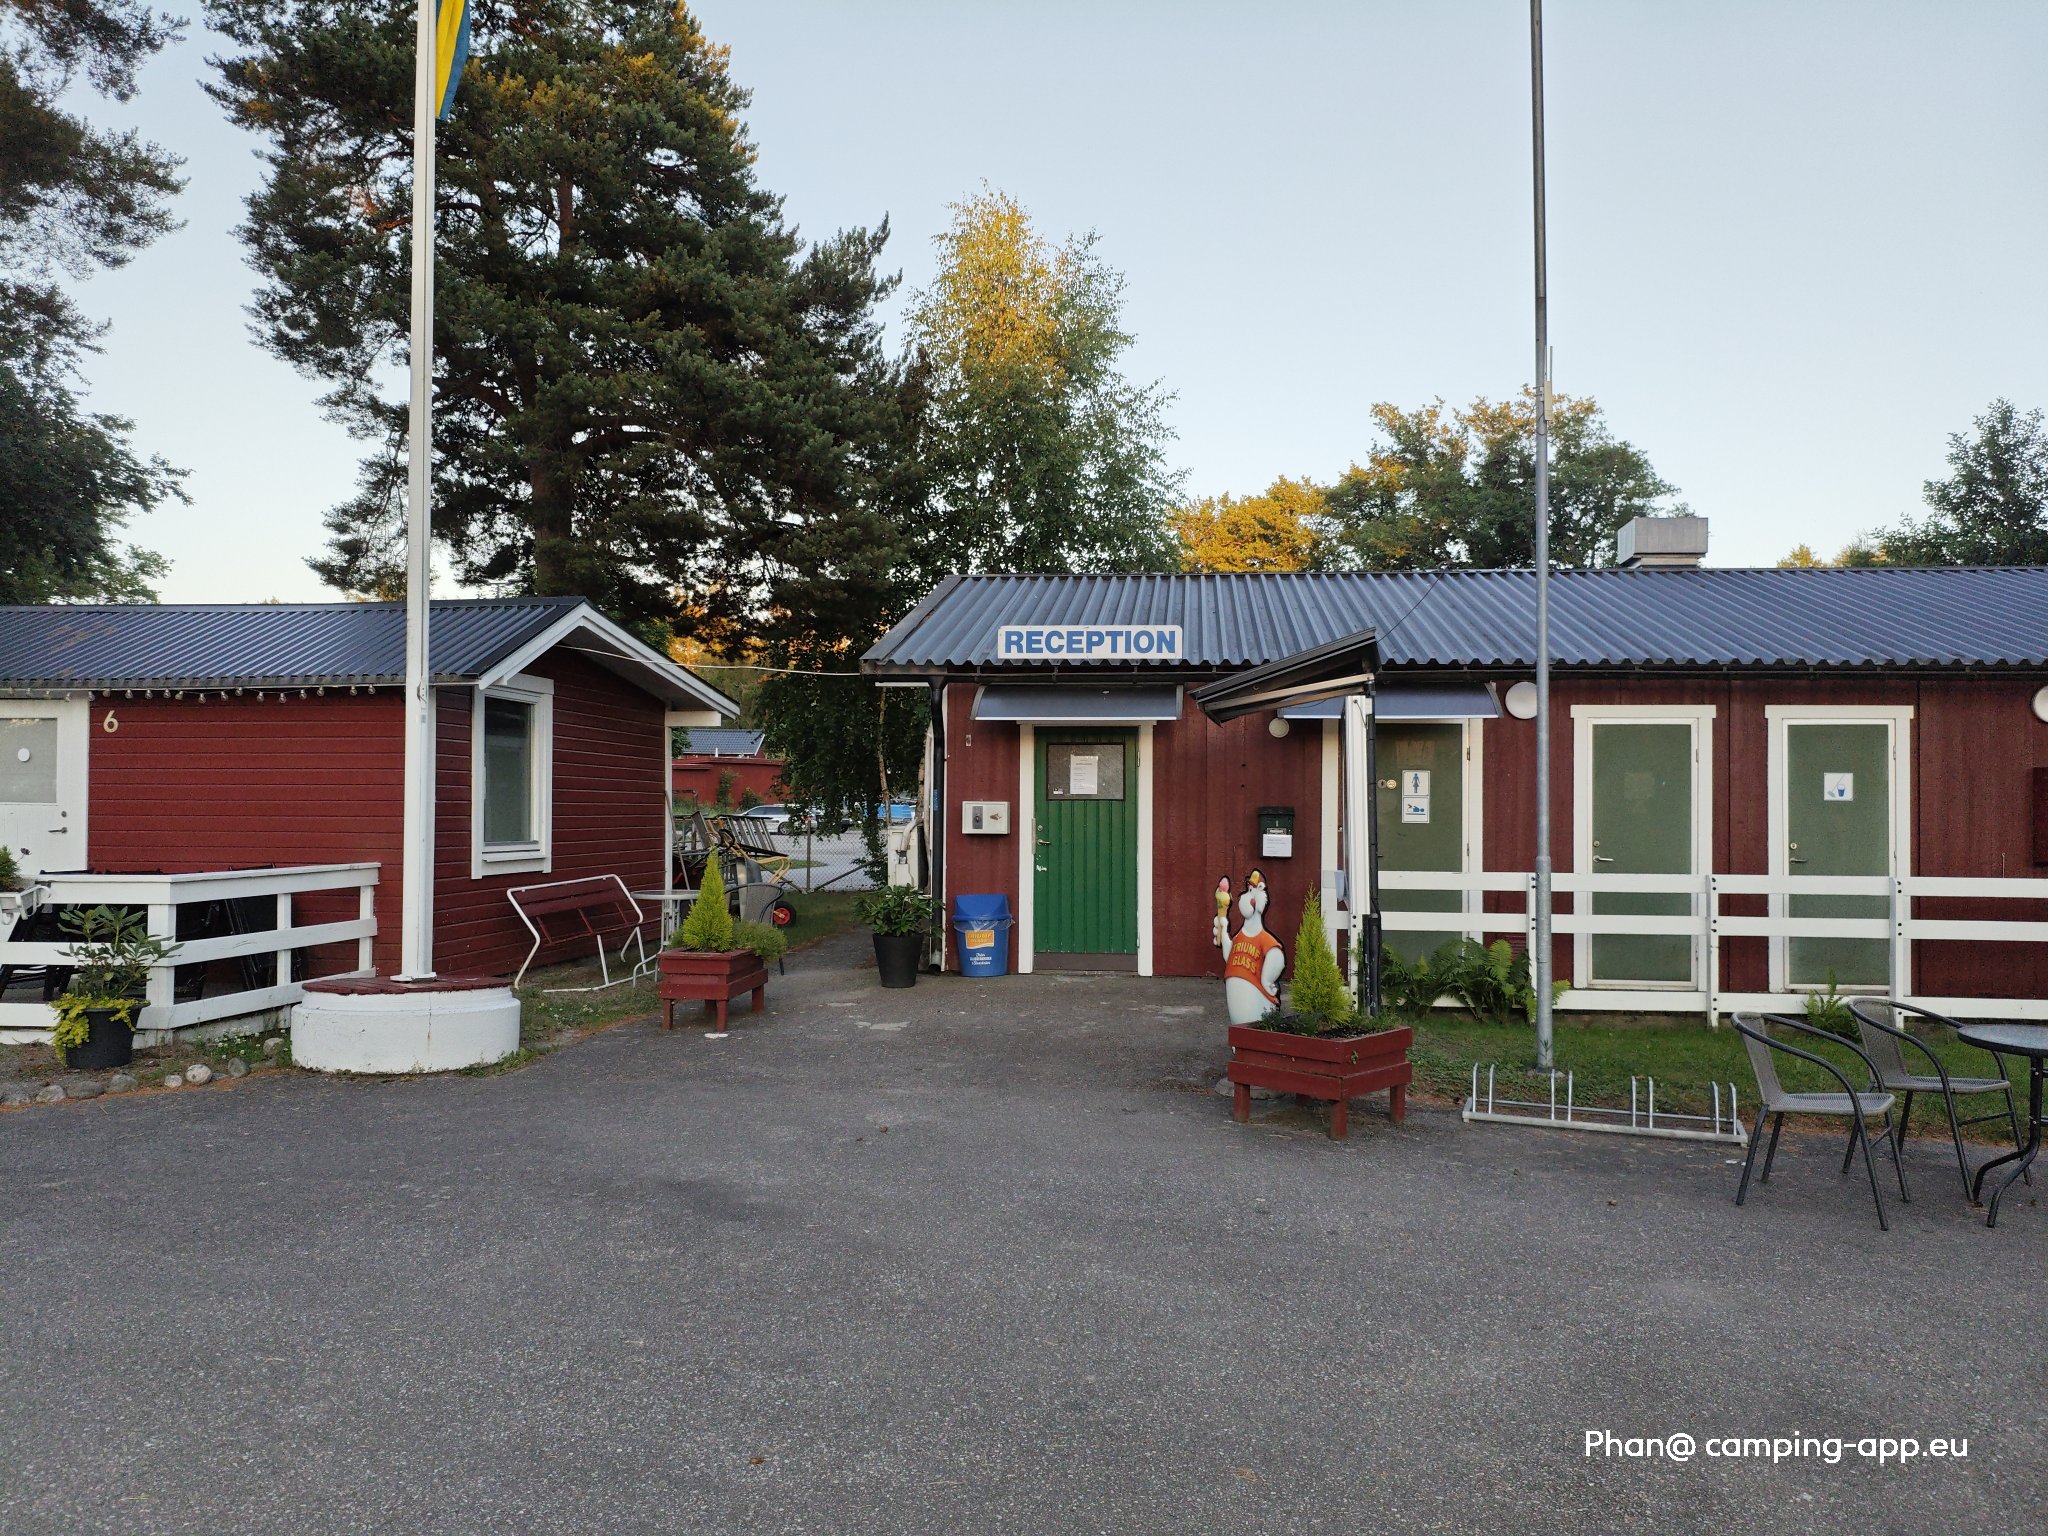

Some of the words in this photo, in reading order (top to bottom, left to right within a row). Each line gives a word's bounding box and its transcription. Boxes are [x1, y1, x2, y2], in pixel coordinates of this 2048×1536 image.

[1004, 630, 1176, 654] RECEPTION
[103, 710, 119, 733] 6
[1233, 942, 1260, 959] TRIUMF
[1232, 955, 1256, 973] GLASS
